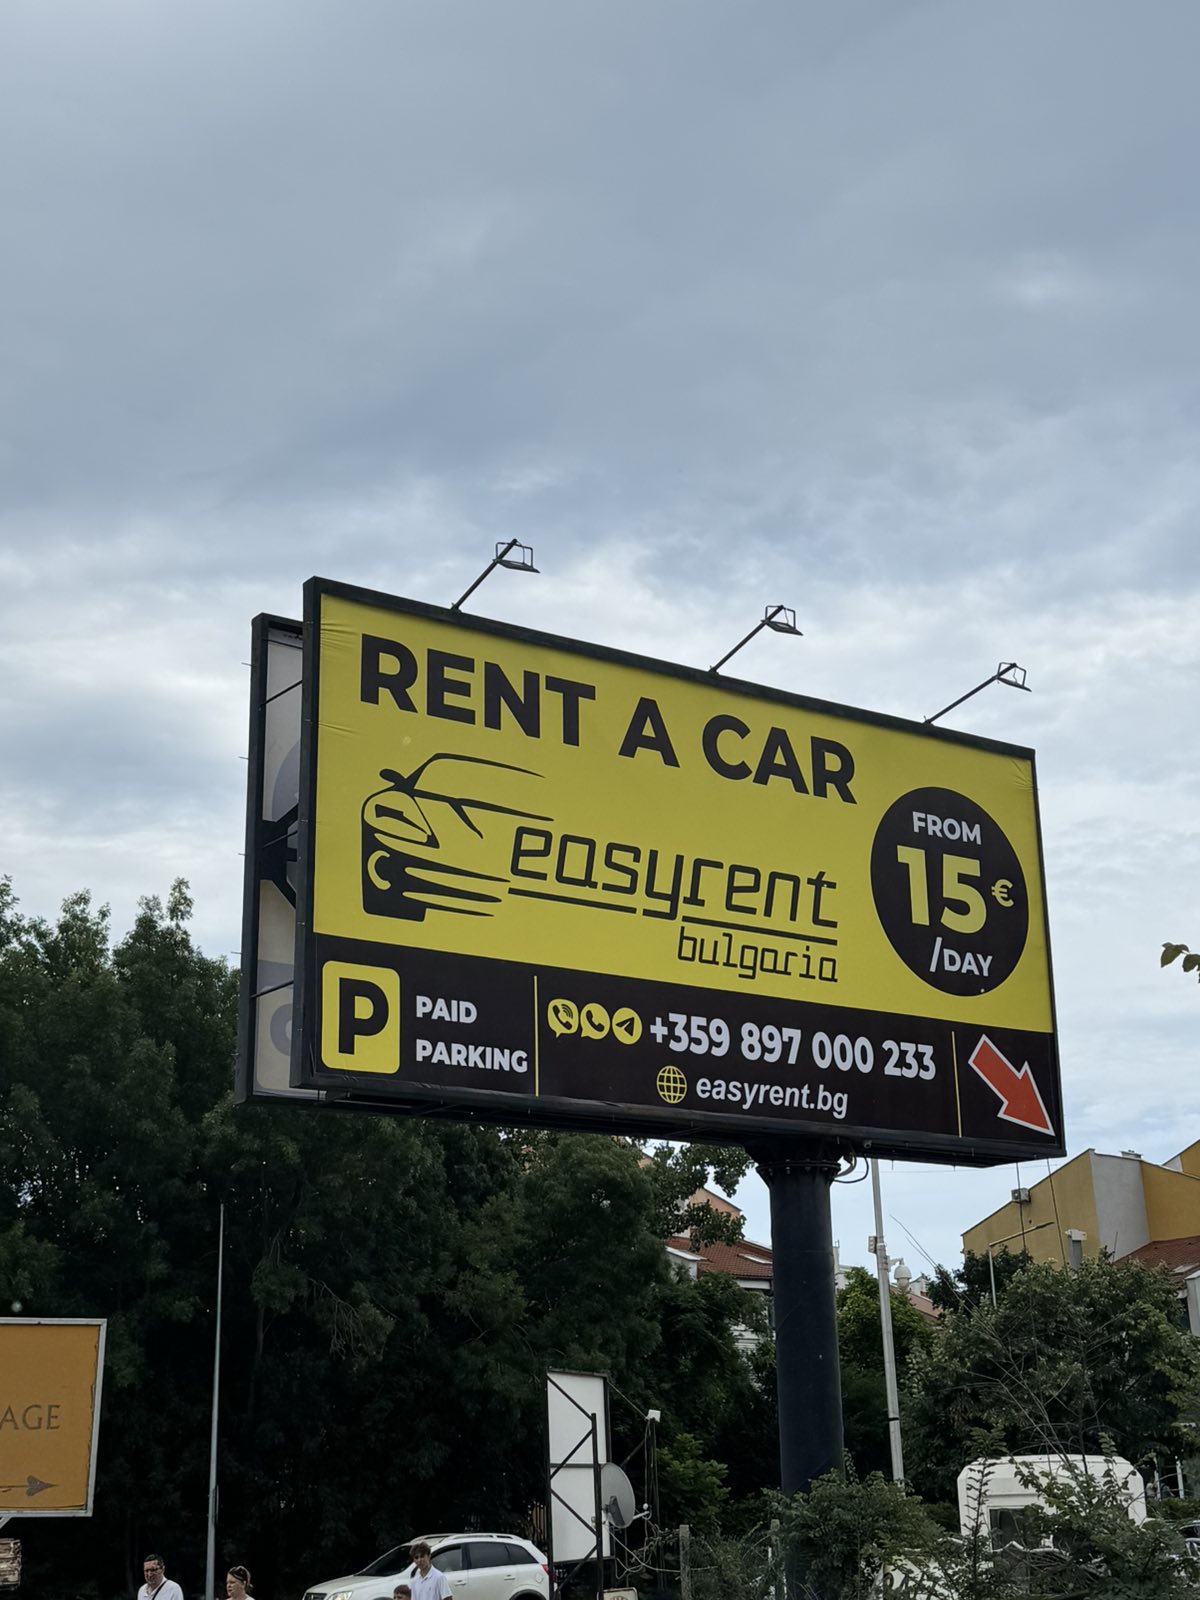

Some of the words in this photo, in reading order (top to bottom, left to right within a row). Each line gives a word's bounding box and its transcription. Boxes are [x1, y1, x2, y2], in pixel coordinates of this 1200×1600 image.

[360, 633, 595, 747] RENT
[618, 697, 680, 767] A
[702, 714, 858, 804] CAR
[912, 811, 982, 845] FROM
[511, 826, 838, 928] easyrent
[677, 926, 838, 982] bulgaria
[929, 937, 993, 977] /DAY
[338, 977, 389, 1055] P
[415, 995, 477, 1024] PAID
[415, 1038, 528, 1073] PARKING
[649, 1013, 731, 1057] +359
[740, 1022, 802, 1065] 897
[811, 1032, 875, 1073] 000
[882, 1040, 936, 1081] 233
[695, 1076, 849, 1119] easyrent.bg
[0, 1404, 61, 1430] AGE
